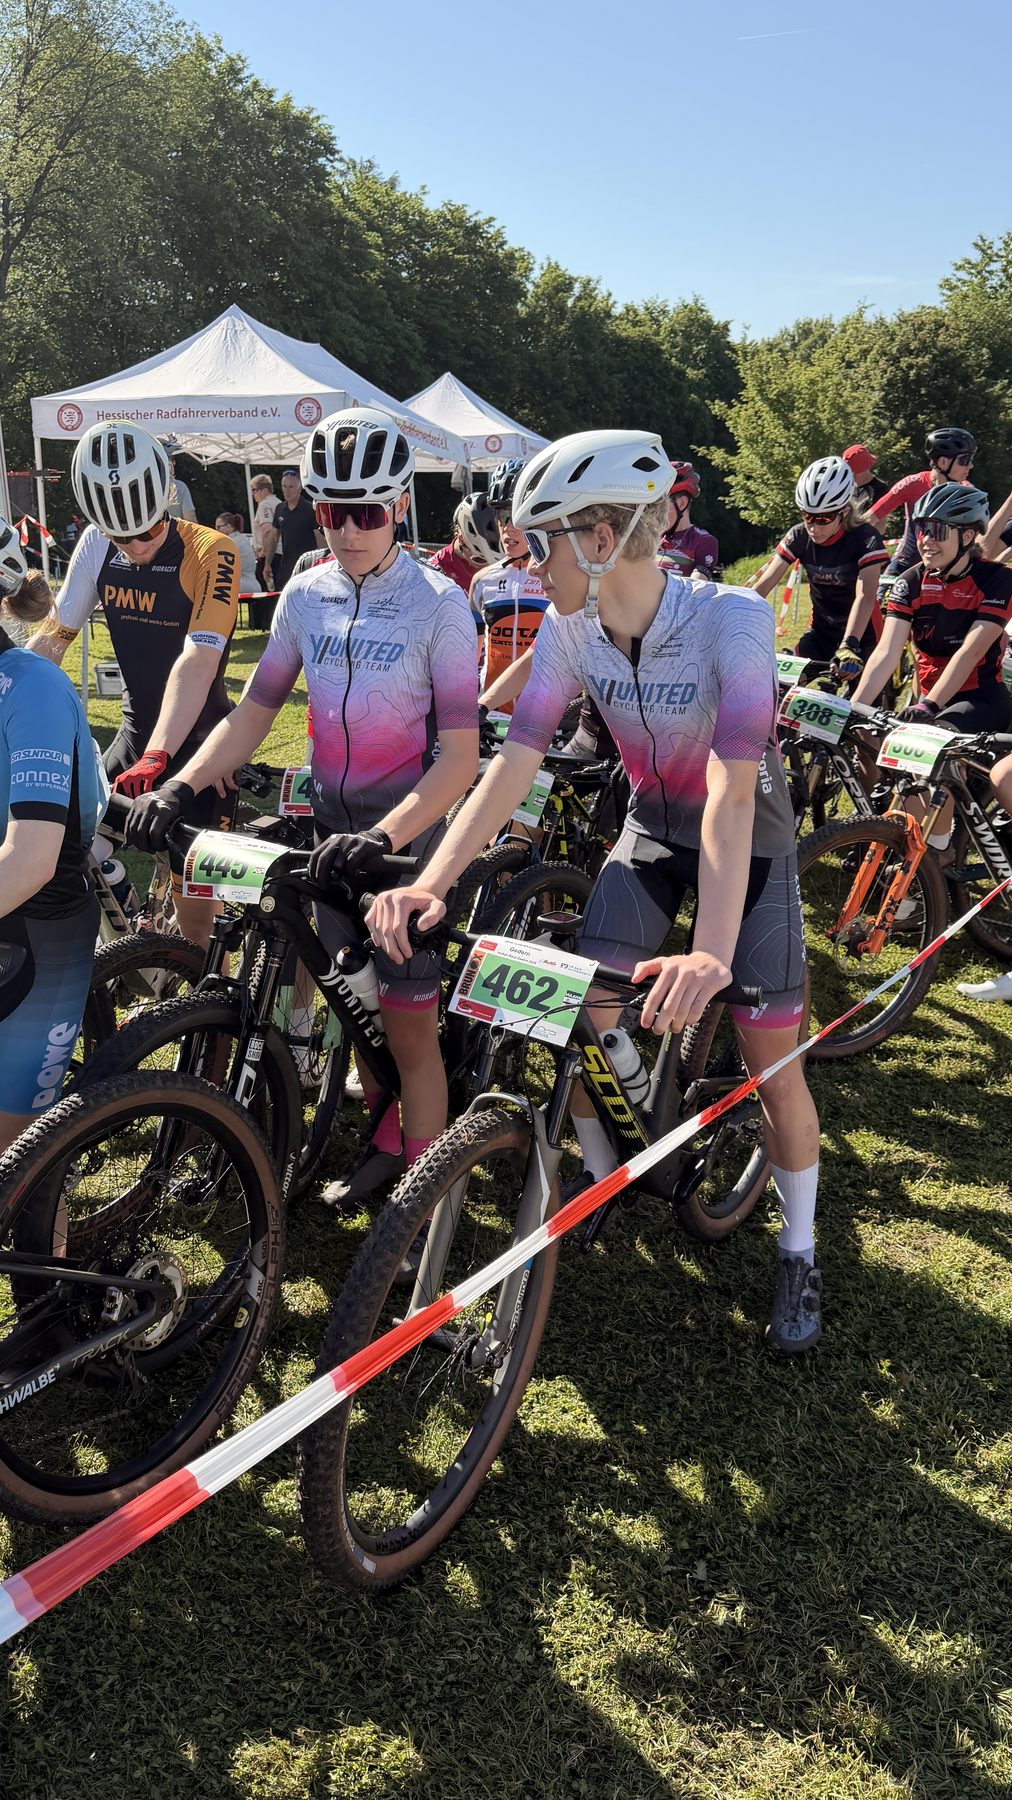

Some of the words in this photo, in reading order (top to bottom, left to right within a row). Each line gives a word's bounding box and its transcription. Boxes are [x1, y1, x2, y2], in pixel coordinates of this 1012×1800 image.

[96, 410, 153, 421] Hessischer
[156, 407, 258, 419] Radfahrerverband
[261, 407, 281, 417] e.V.
[217, 550, 235, 606] PMW
[104, 584, 157, 613] PMW
[324, 657, 361, 669] CYCLING
[365, 661, 391, 673] TEAM
[613, 701, 655, 713] CYCLING
[659, 705, 687, 715] TEAM
[792, 699, 833, 726] 308
[11, 771, 70, 788] connex
[481, 964, 559, 1012] 462
